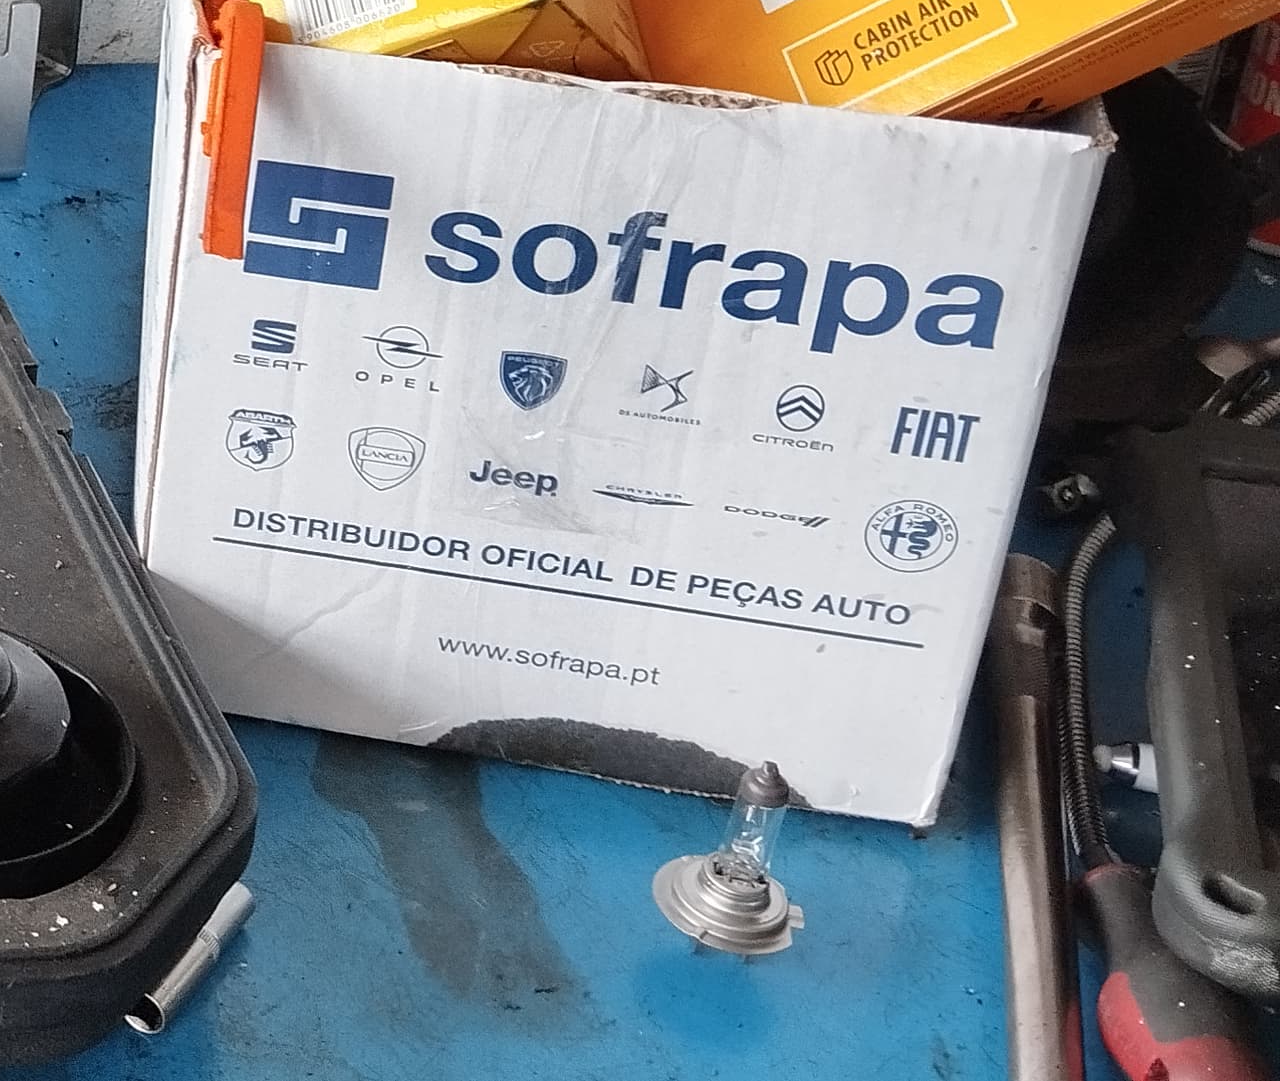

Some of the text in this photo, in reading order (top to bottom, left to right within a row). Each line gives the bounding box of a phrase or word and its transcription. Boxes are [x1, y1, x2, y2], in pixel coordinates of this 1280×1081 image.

[853, 10, 913, 51] CABIN
[860, 1, 979, 71] PROTECTION
[426, 212, 1006, 356] sofrapa
[233, 354, 308, 371] SEAT
[506, 356, 561, 368] PEUGEOT
[355, 371, 440, 392] OPEL
[619, 409, 701, 426] DS AUTOMOBILES
[752, 433, 834, 452] CITROËN
[890, 407, 981, 463] FIAT
[362, 450, 409, 463] LANCIA
[470, 460, 559, 497] Jeep
[606, 485, 682, 499] CHRYSLER
[724, 505, 812, 527] DODGE
[871, 503, 954, 543] ALFA ROMEO
[233, 508, 911, 625] DISTRIBUIDOR OFICIAL DE PEÇAS AUTO
[438, 636, 660, 686] www.sofrapa.pt
